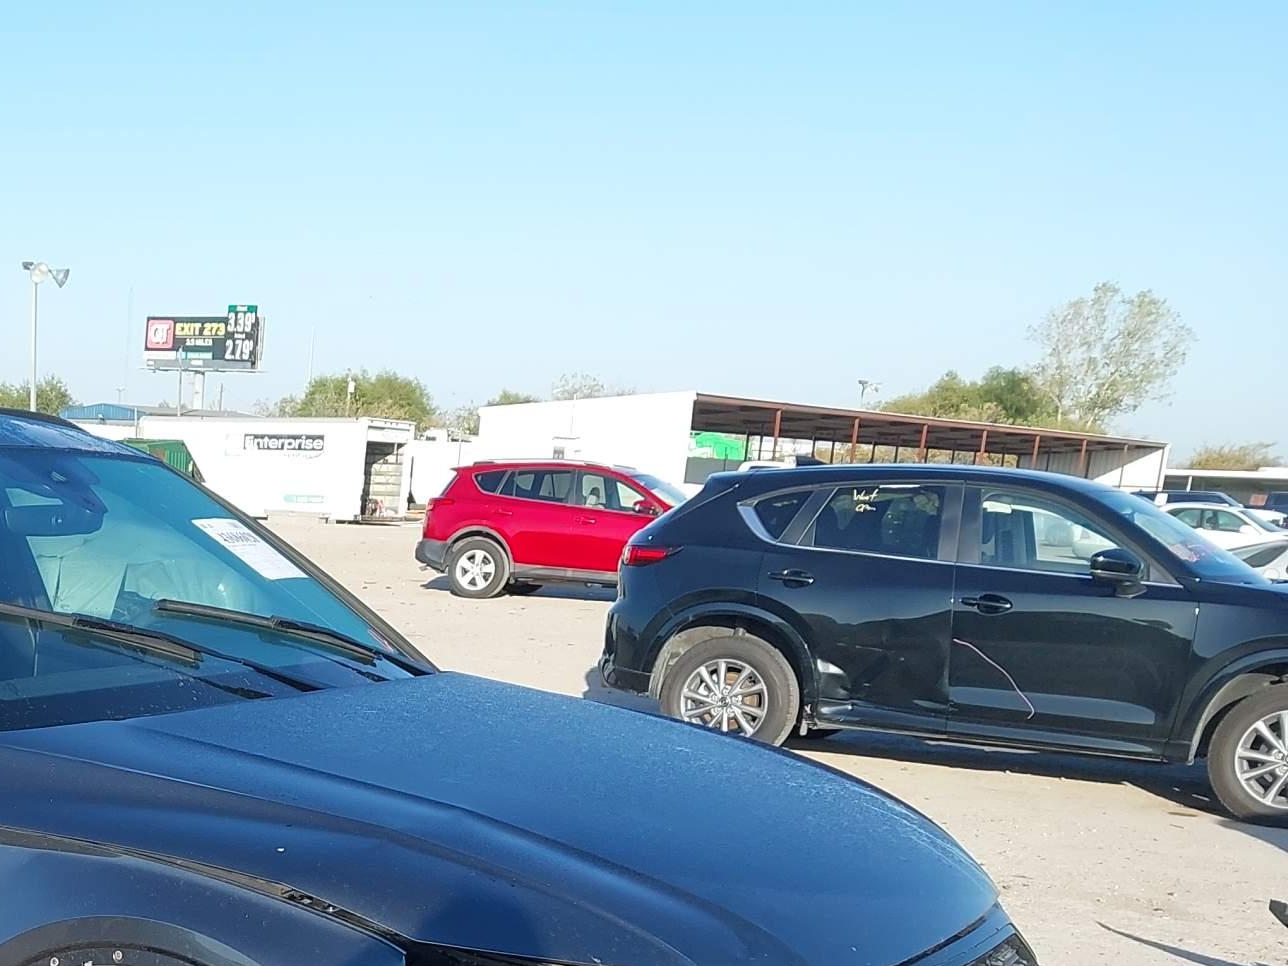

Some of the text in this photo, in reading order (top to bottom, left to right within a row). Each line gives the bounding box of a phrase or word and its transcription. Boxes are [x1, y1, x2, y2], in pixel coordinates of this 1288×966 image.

[175, 322, 202, 336] EXIT
[203, 322, 226, 336] 273
[245, 435, 324, 451] Enterprise
